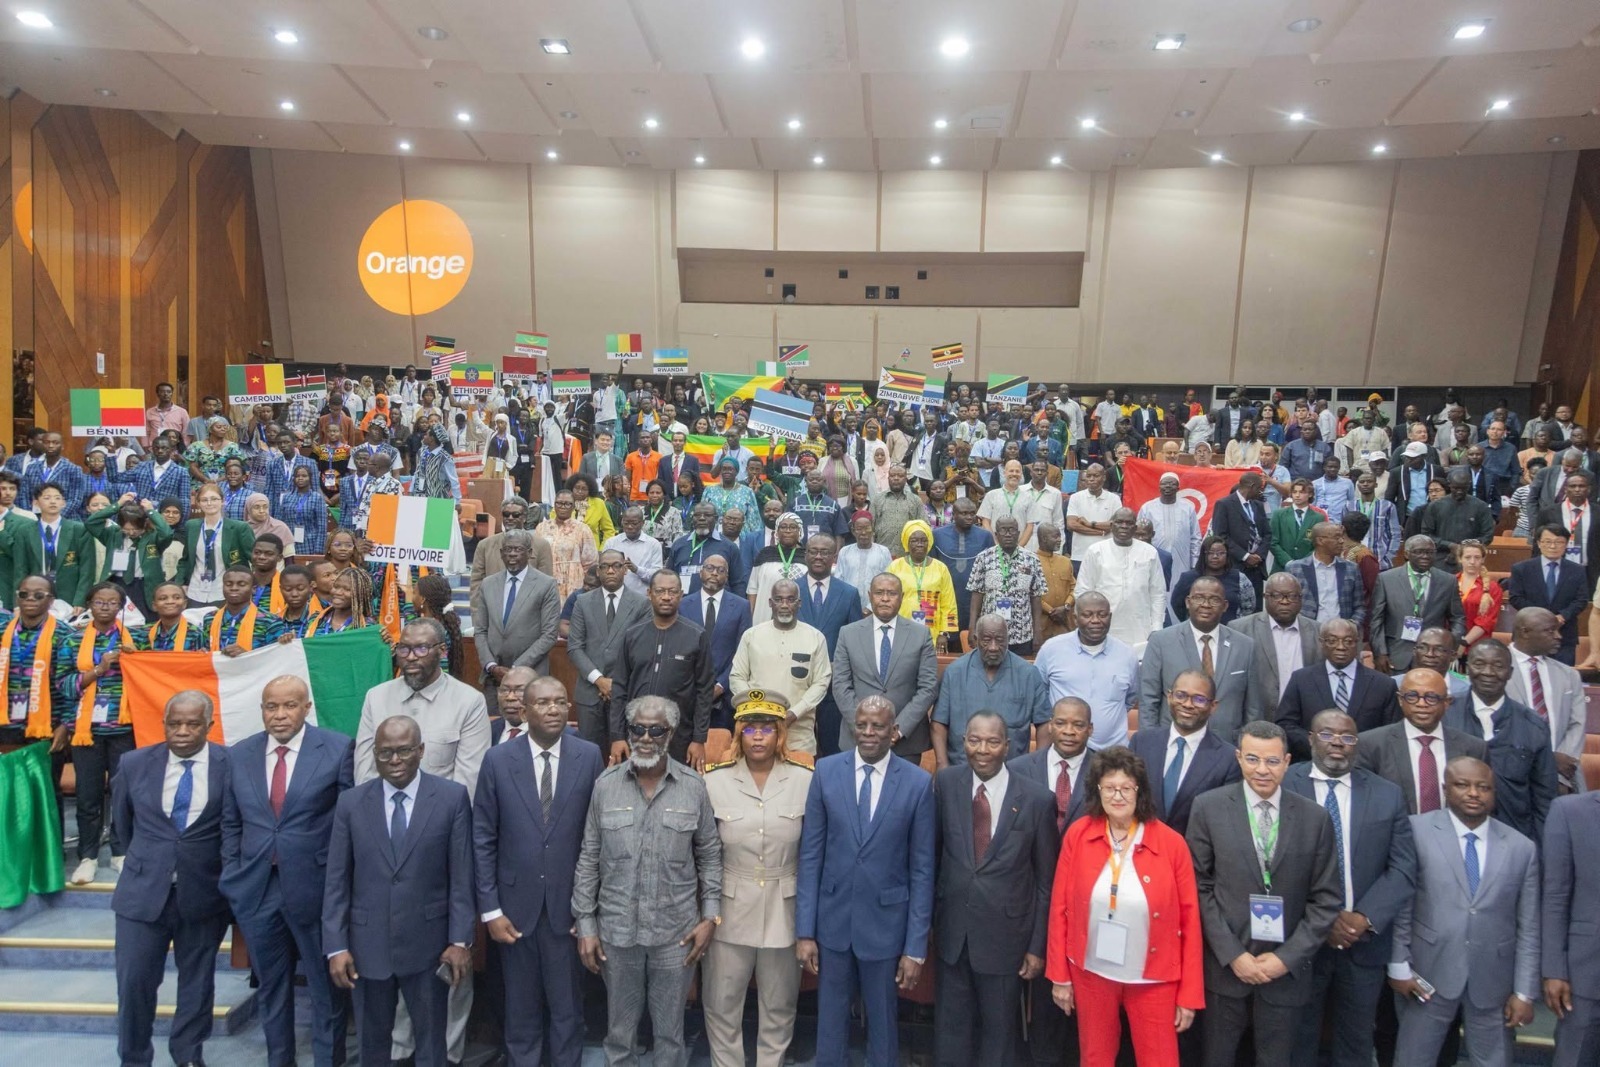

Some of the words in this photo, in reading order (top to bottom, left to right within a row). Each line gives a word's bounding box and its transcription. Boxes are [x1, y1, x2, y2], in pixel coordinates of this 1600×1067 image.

[366, 251, 465, 280] Orange
[935, 359, 962, 367] OUGANDA
[291, 392, 318, 400] KENYA
[453, 387, 492, 395] ÉTHIOPIE
[879, 390, 920, 402] ZIMBABWE
[990, 394, 1023, 403] TANZANIE
[86, 426, 129, 435] BÉNIN
[753, 422, 803, 441] BOTSWANA
[398, 548, 444, 562] D'IVOIRE
[29, 660, 46, 713] Orange
